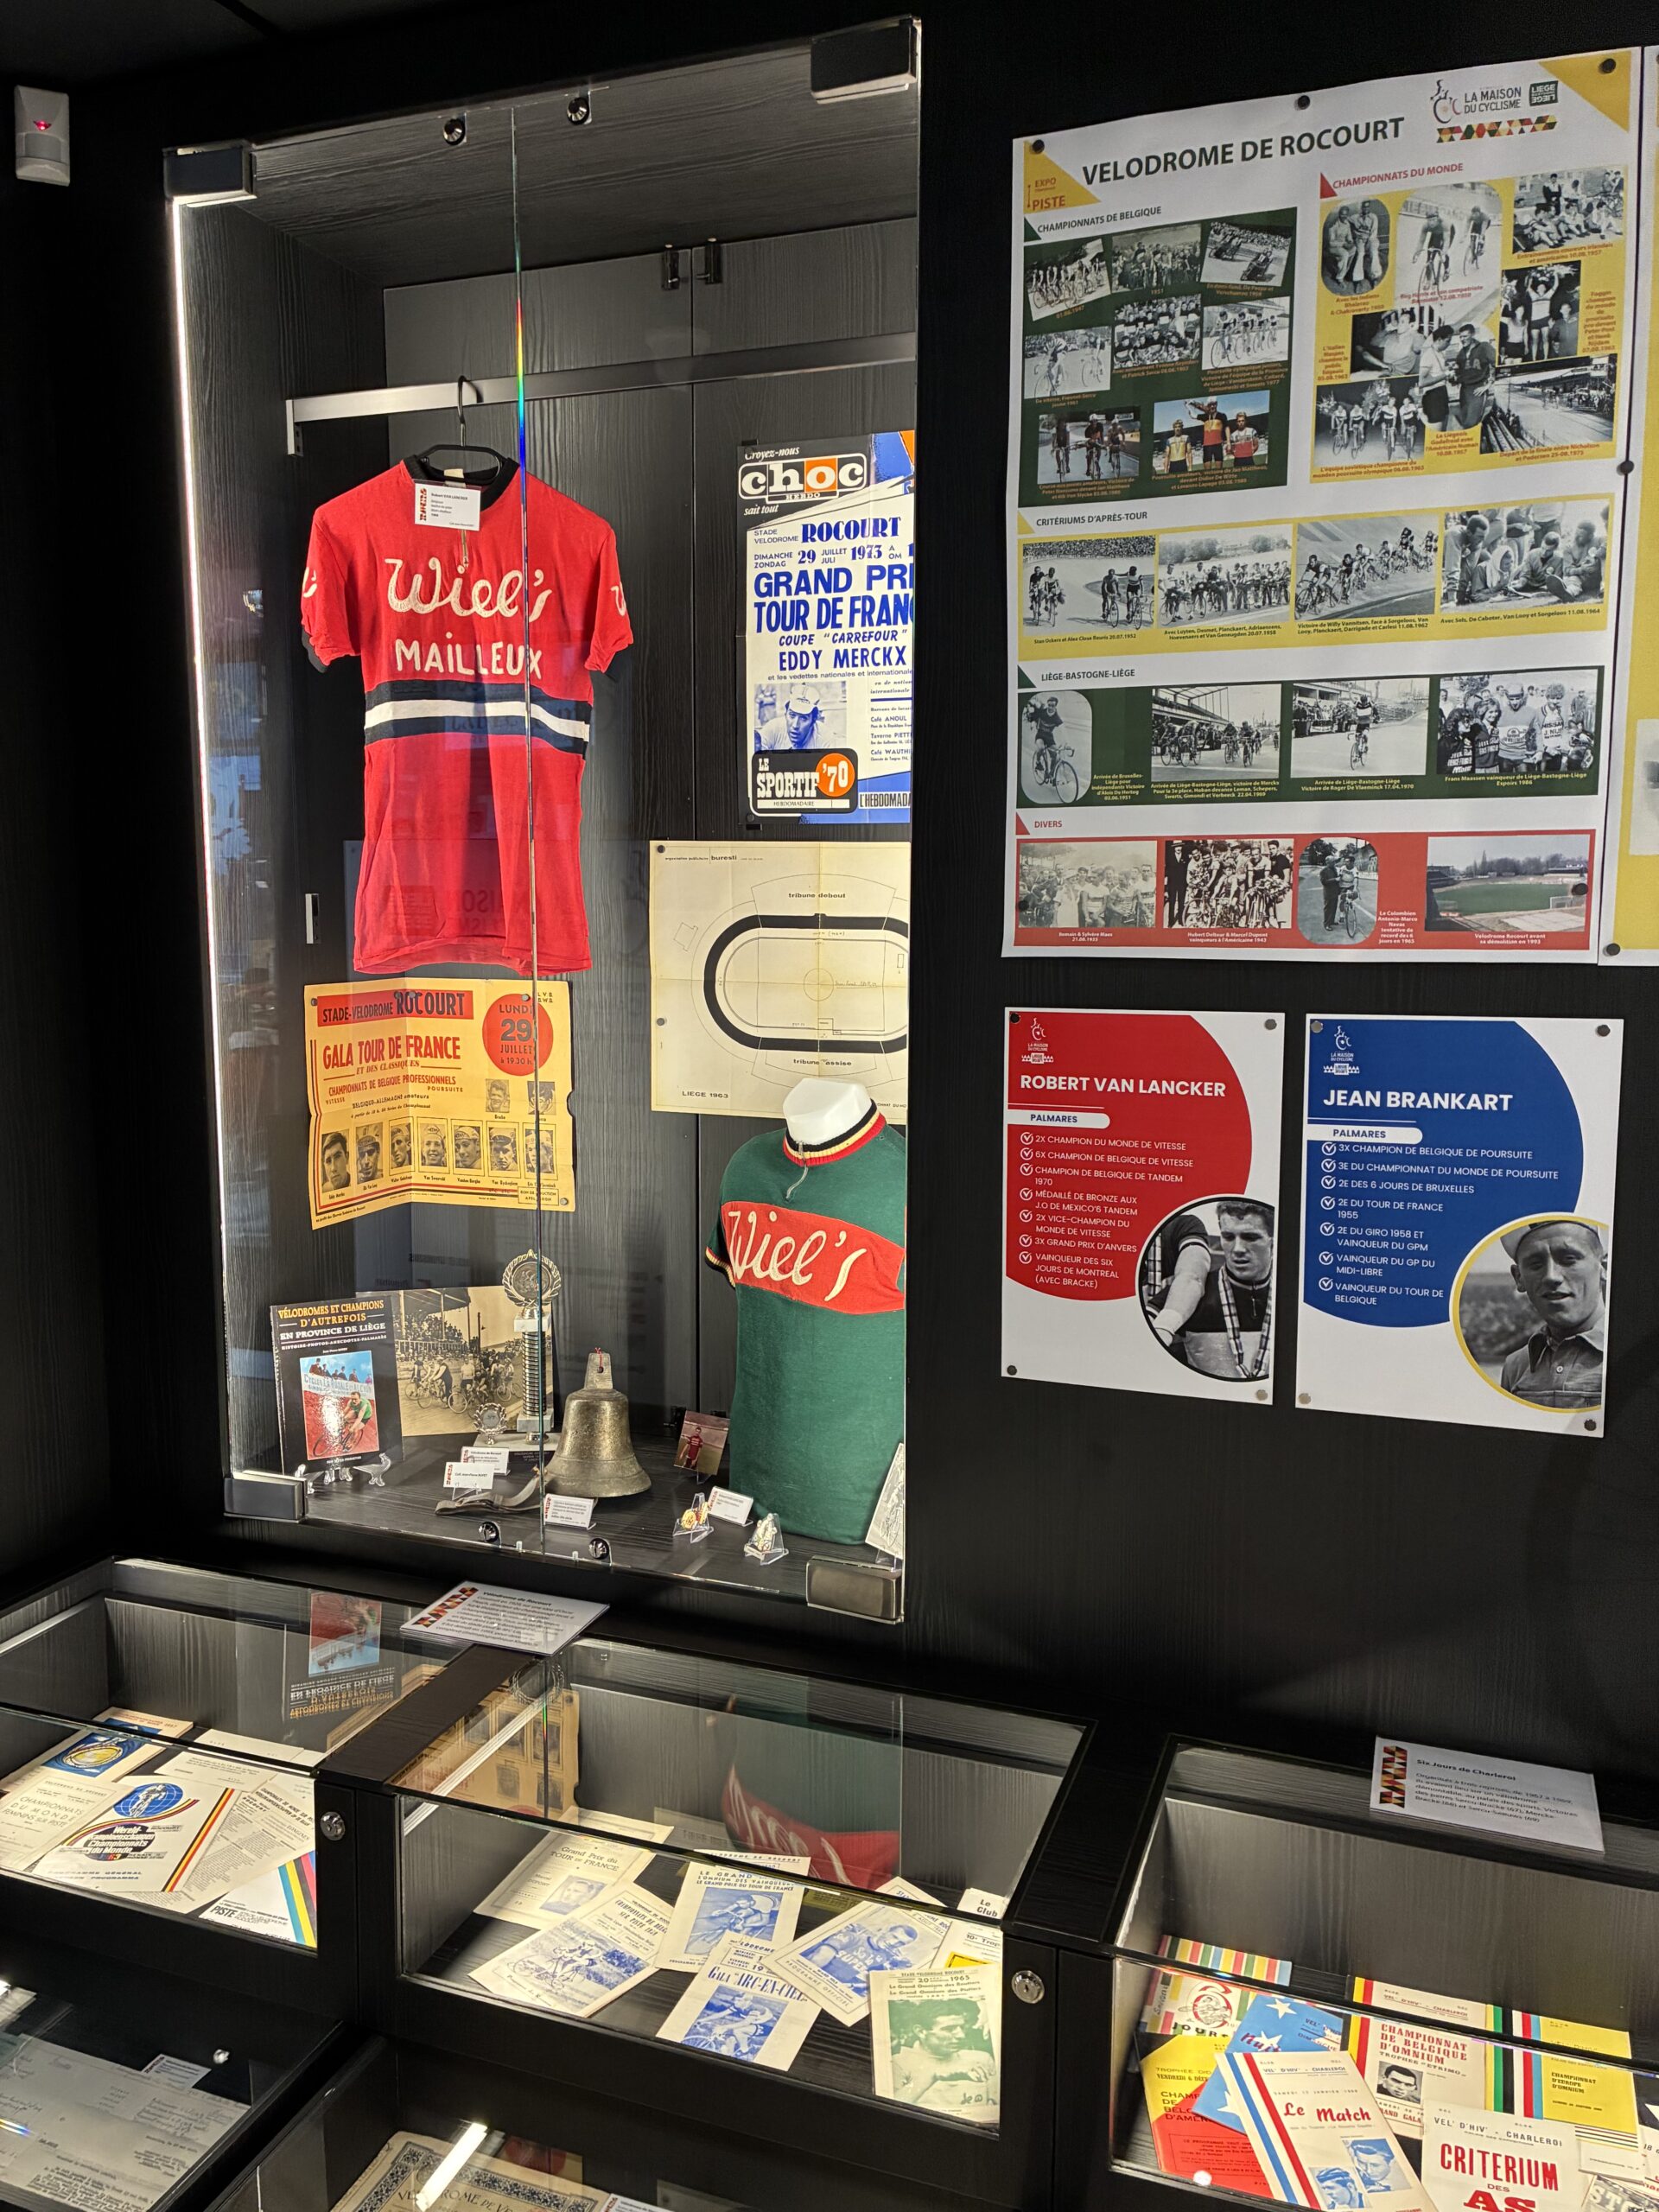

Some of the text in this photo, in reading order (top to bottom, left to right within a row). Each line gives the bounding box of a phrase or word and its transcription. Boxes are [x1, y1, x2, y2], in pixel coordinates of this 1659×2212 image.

[1465, 86, 1521, 104] LA MAISON
[1531, 84, 1555, 92] LIEGE
[1464, 99, 1520, 114] DU CYCLISME
[1082, 117, 1404, 186] VELODROME DE ROCOURT
[1034, 177, 1056, 188] EXPO
[1332, 161, 1463, 189] CHAMPIONNATS DU MONDE
[1033, 195, 1065, 211] PISTE
[1037, 206, 1161, 233] CHAMPIONNATS DE BELGIQUE
[741, 462, 863, 495] choc
[744, 505, 779, 515] sait tout
[1036, 512, 1147, 526] CRITÉRIUMS D'APRÈS-TOUR
[754, 517, 901, 544] VELODROME ROCOURT
[798, 550, 817, 564] 29
[821, 548, 847, 556] JUILLET
[851, 544, 882, 561] 1973
[753, 567, 853, 598] GRAND
[753, 593, 914, 633] TOUR DE FRAN
[779, 634, 816, 646] COUPE
[395, 632, 542, 679] MAILLEUX
[779, 645, 906, 671] EDDY MERCKX
[1041, 668, 1135, 682] LIÈGE-BASTOGNE-LIÈGE
[759, 758, 769, 771] LE
[757, 772, 820, 798] SPORTIF
[323, 992, 465, 1022] STADE-VELODROME ROCOURT
[500, 1018, 532, 1042] 29
[322, 1034, 461, 1070] GALA TOUR DE FRANCE
[500, 1044, 533, 1054] JUILLET
[356, 1059, 420, 1075] ET DES CLASSIQUES
[328, 1074, 456, 1096] CHAMPIONNATS DE BELGIQUE PROFESSIONNELS
[1020, 1074, 1225, 1096] ROBERT VAN LANCKER
[1323, 1090, 1513, 1111] JEAN BRANKART
[1030, 1113, 1077, 1123] PALMARES
[1332, 1128, 1386, 1139] PALMARES
[1047, 1135, 1092, 1145] CHAMPION
[1108, 1139, 1139, 1148] MONDE
[1141, 1141, 1152, 1149] DE
[1154, 1141, 1186, 1151] VITESSE
[1338, 1142, 1533, 1160] 3X CHAMPION DE BELGIQUE DE POURSUITE
[1338, 1198, 1443, 1212] 2E DU TOUR DE FRANCE
[1338, 1210, 1358, 1219] 1955
[1035, 1252, 1113, 1267] VAINQUEUR DES SIX
[1035, 1264, 1119, 1279] JOURS DE MONTREAL
[1035, 1274, 1097, 1289] (AVEC BRACKE)
[278, 1300, 385, 1319] VÉLODROMES ET CHAMPIONS
[300, 1313, 366, 1327] D'AUTREFOIS
[280, 1332, 293, 1340] EN
[296, 1327, 342, 1338] PROVINCE
[359, 1322, 385, 1332] LIÈGE
[1432, 1762, 1457, 1771] Jours
[1471, 1768, 1516, 1781] Charleroi
[562, 1847, 586, 1857] Grand
[550, 1852, 620, 1872] TOUR FRANCE
[210, 1906, 238, 1918] PISTE
[976, 1907, 998, 1917] Club
[1381, 2023, 1468, 2051] CHAMPIONNAT
[1380, 2042, 1445, 2064] D'OMNIUM
[1381, 2032, 1467, 2061] DE BELGIQUE
[1284, 2102, 1371, 2122] Le Match
[1506, 2131, 1563, 2147] CHARLEROI
[1440, 2143, 1559, 2191] CRITERIUM
[1487, 2183, 1510, 2193] DES
[1463, 2190, 1536, 2212] AS
